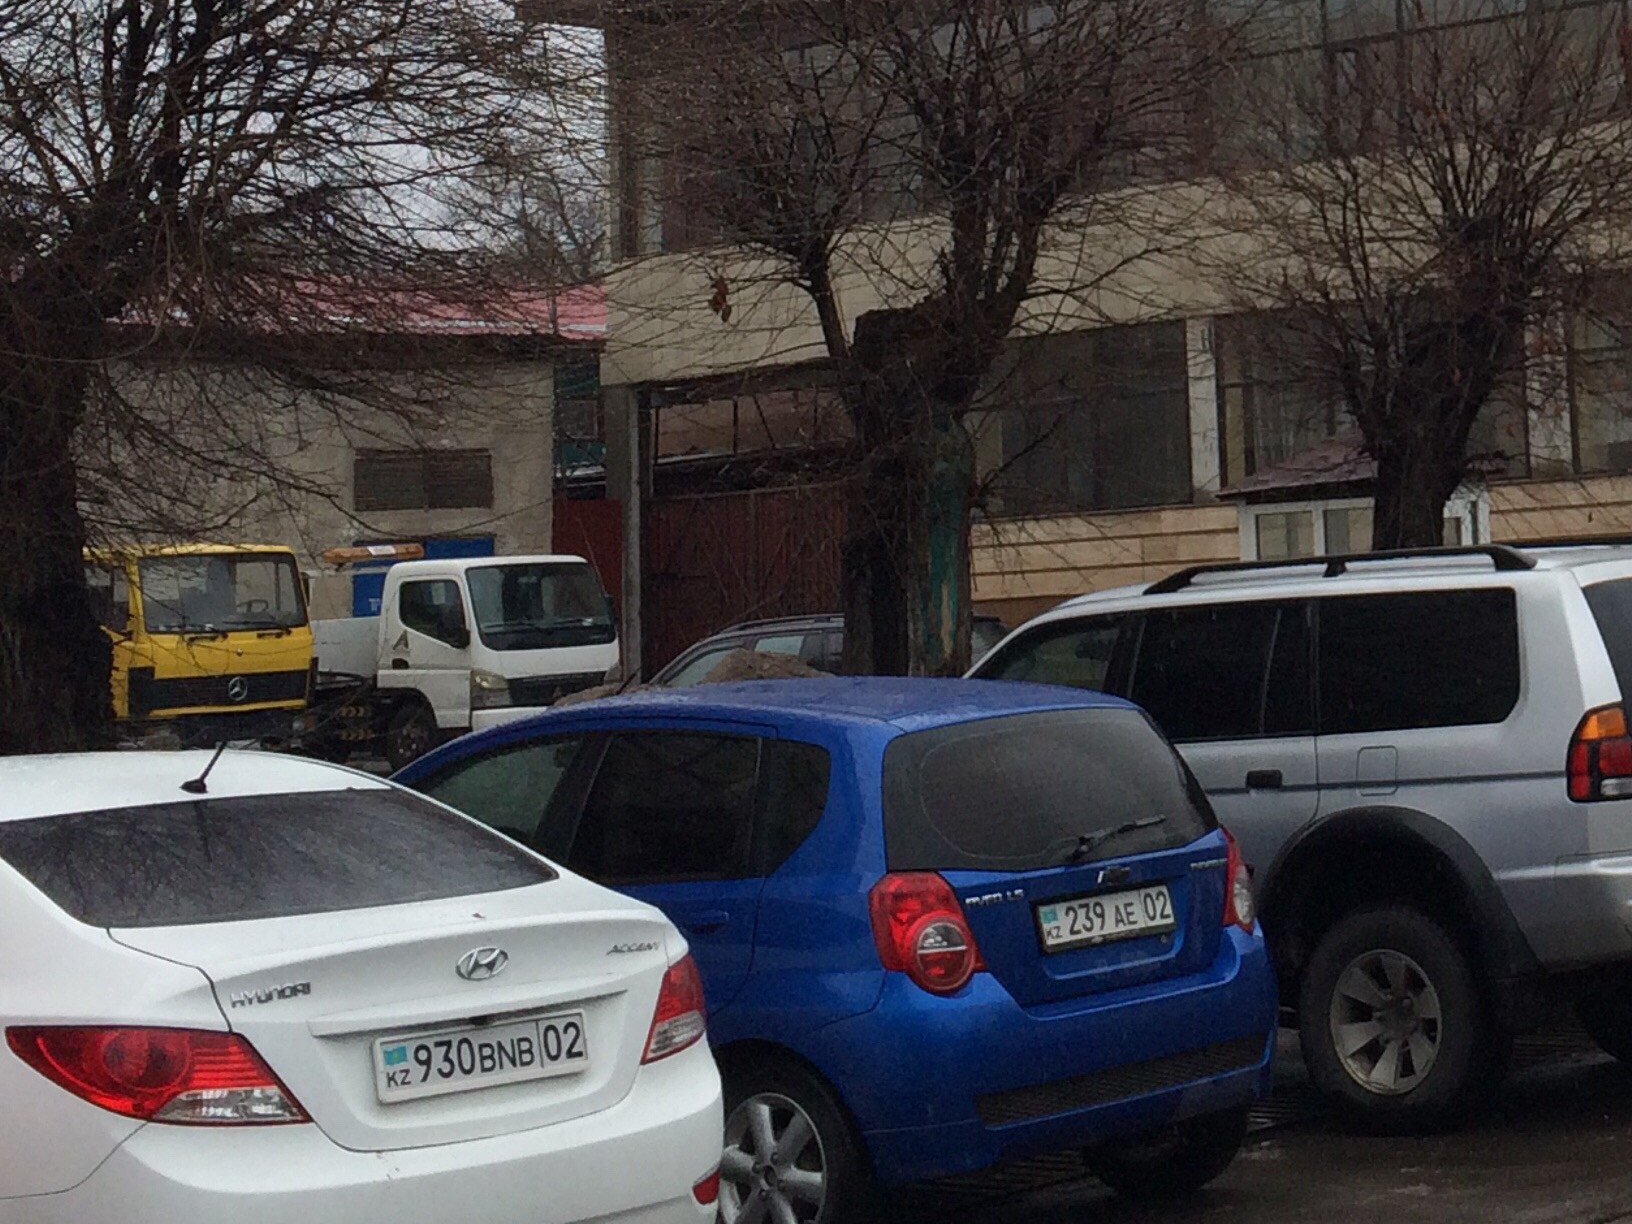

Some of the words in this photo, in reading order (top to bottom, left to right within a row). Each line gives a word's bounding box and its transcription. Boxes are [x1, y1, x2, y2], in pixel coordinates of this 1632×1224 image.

[1065, 901, 1105, 935] 239
[1115, 902, 1138, 928] AE
[1143, 890, 1171, 921] 02
[231, 981, 310, 1008] HYUNDAI
[387, 1069, 412, 1088] KZ
[543, 1021, 583, 1062] 02
